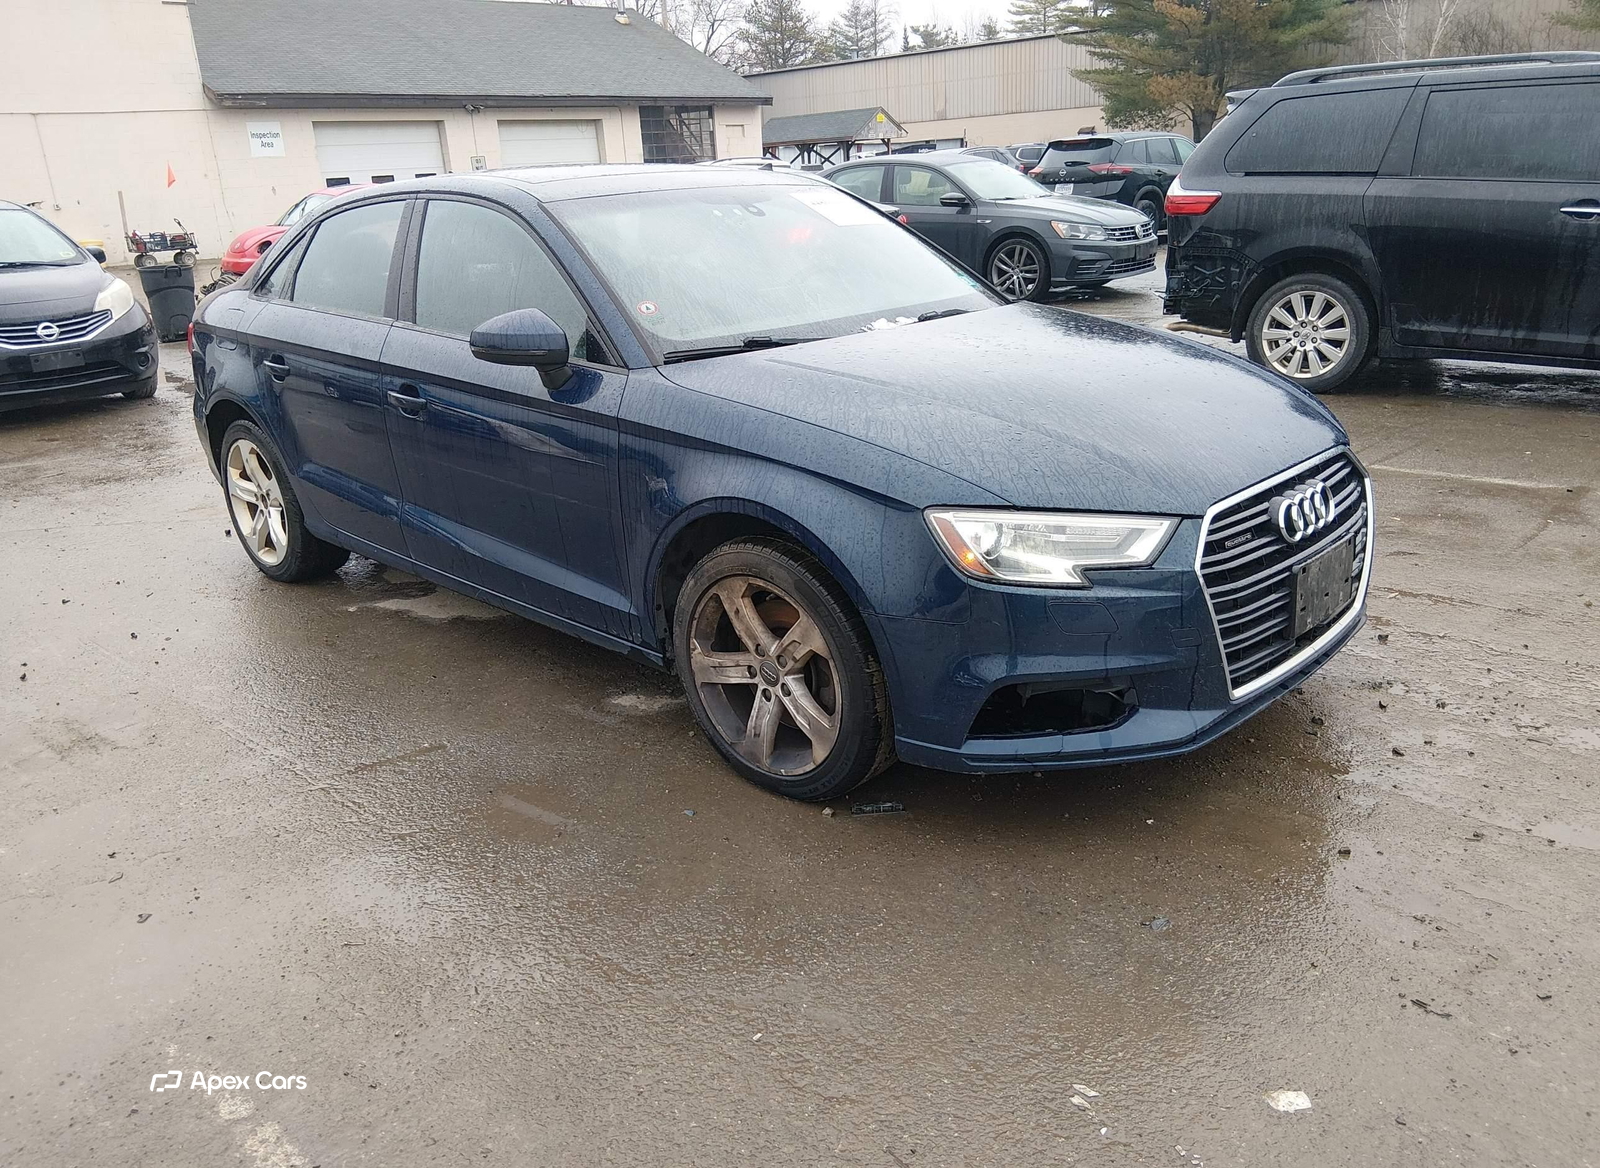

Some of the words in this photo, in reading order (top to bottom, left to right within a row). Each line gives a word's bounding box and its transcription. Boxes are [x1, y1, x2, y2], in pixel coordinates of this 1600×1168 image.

[249, 131, 281, 140] Inspection
[260, 140, 275, 148] Area
[1226, 532, 1252, 548] quattro
